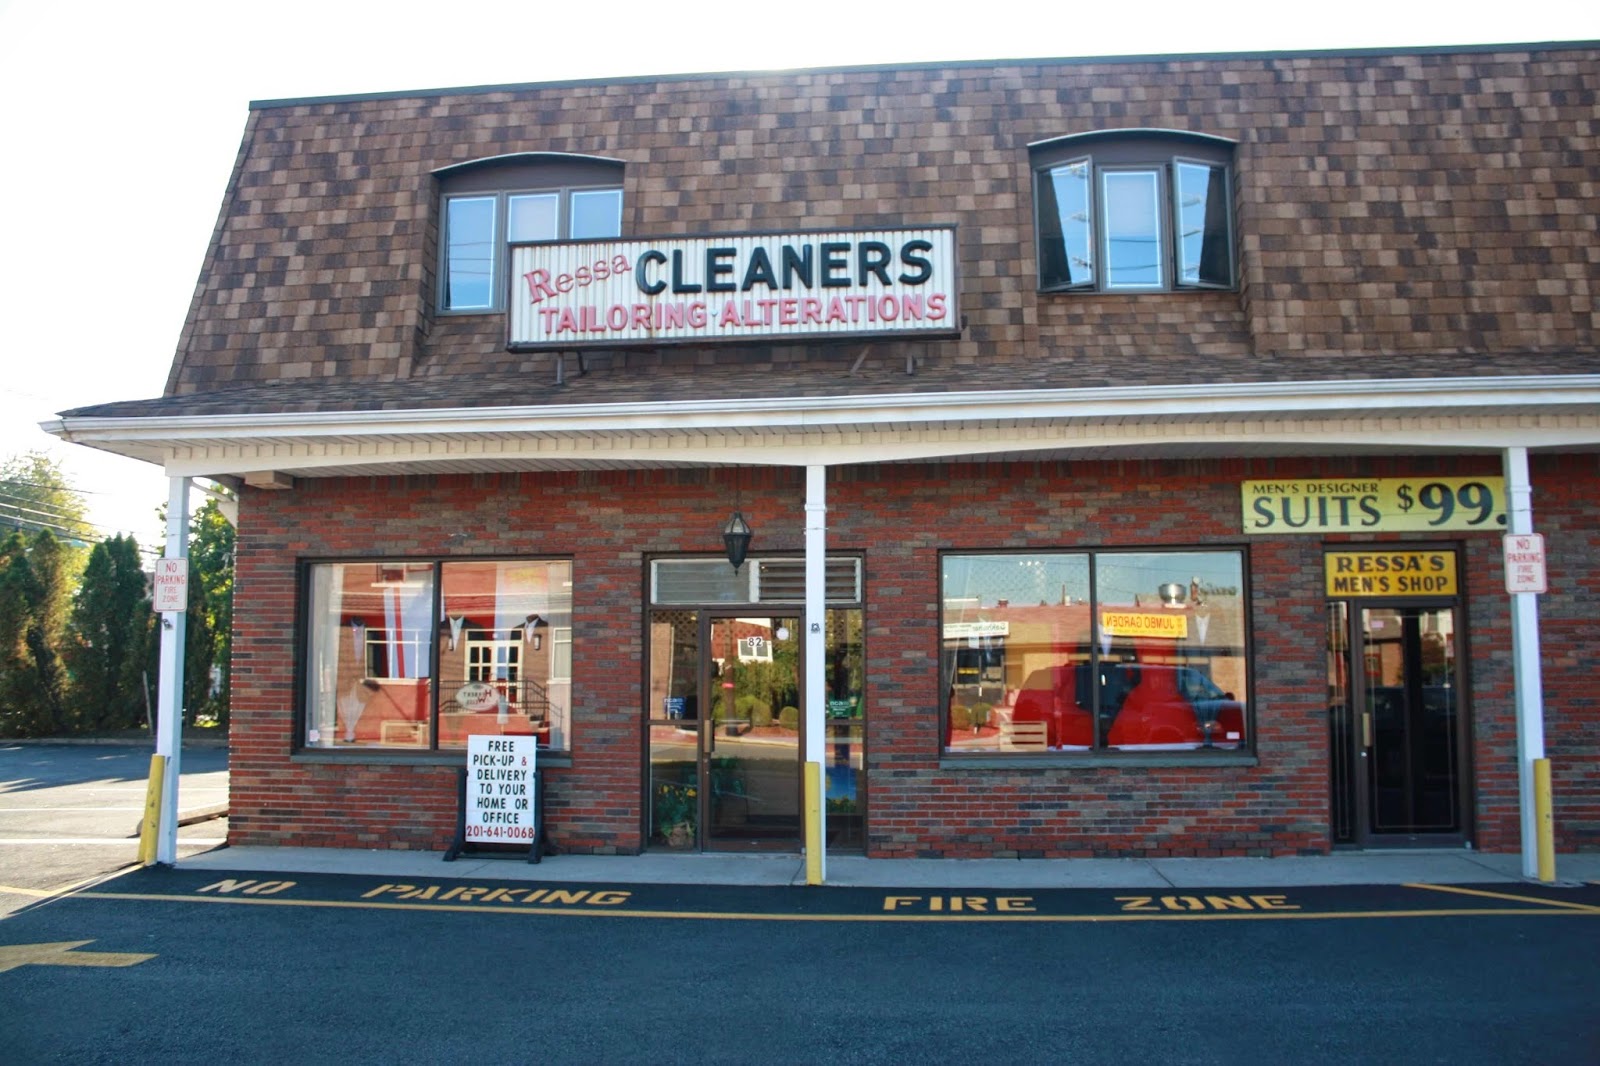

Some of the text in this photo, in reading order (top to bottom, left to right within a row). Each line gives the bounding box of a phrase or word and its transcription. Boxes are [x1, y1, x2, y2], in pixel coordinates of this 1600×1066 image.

[523, 239, 933, 303] Ressa CLEANERS
[540, 293, 947, 333] TAILORING ALTERATIONS
[1253, 482, 1379, 494] MEN'S DESIGNER
[1253, 495, 1381, 528] SUITS
[1516, 539, 1530, 549] NO
[166, 562, 177, 573] NO
[1336, 555, 1445, 572] RESSA'S
[157, 574, 185, 585] PARKING
[1334, 576, 1448, 593] MEN'S SHOP
[164, 586, 177, 594] FIRE
[748, 637, 762, 647] 82
[488, 740, 515, 752] FREE
[473, 754, 527, 766] PICK-UP &
[477, 769, 527, 781] DELIVERY
[480, 783, 526, 795] TO YOUR
[477, 797, 528, 810] HOME OR
[482, 812, 519, 824] OFFICE
[466, 825, 534, 839] 201-641-0068
[196, 879, 632, 905] NO PARKING
[883, 894, 1301, 912] FIRE ZONE
